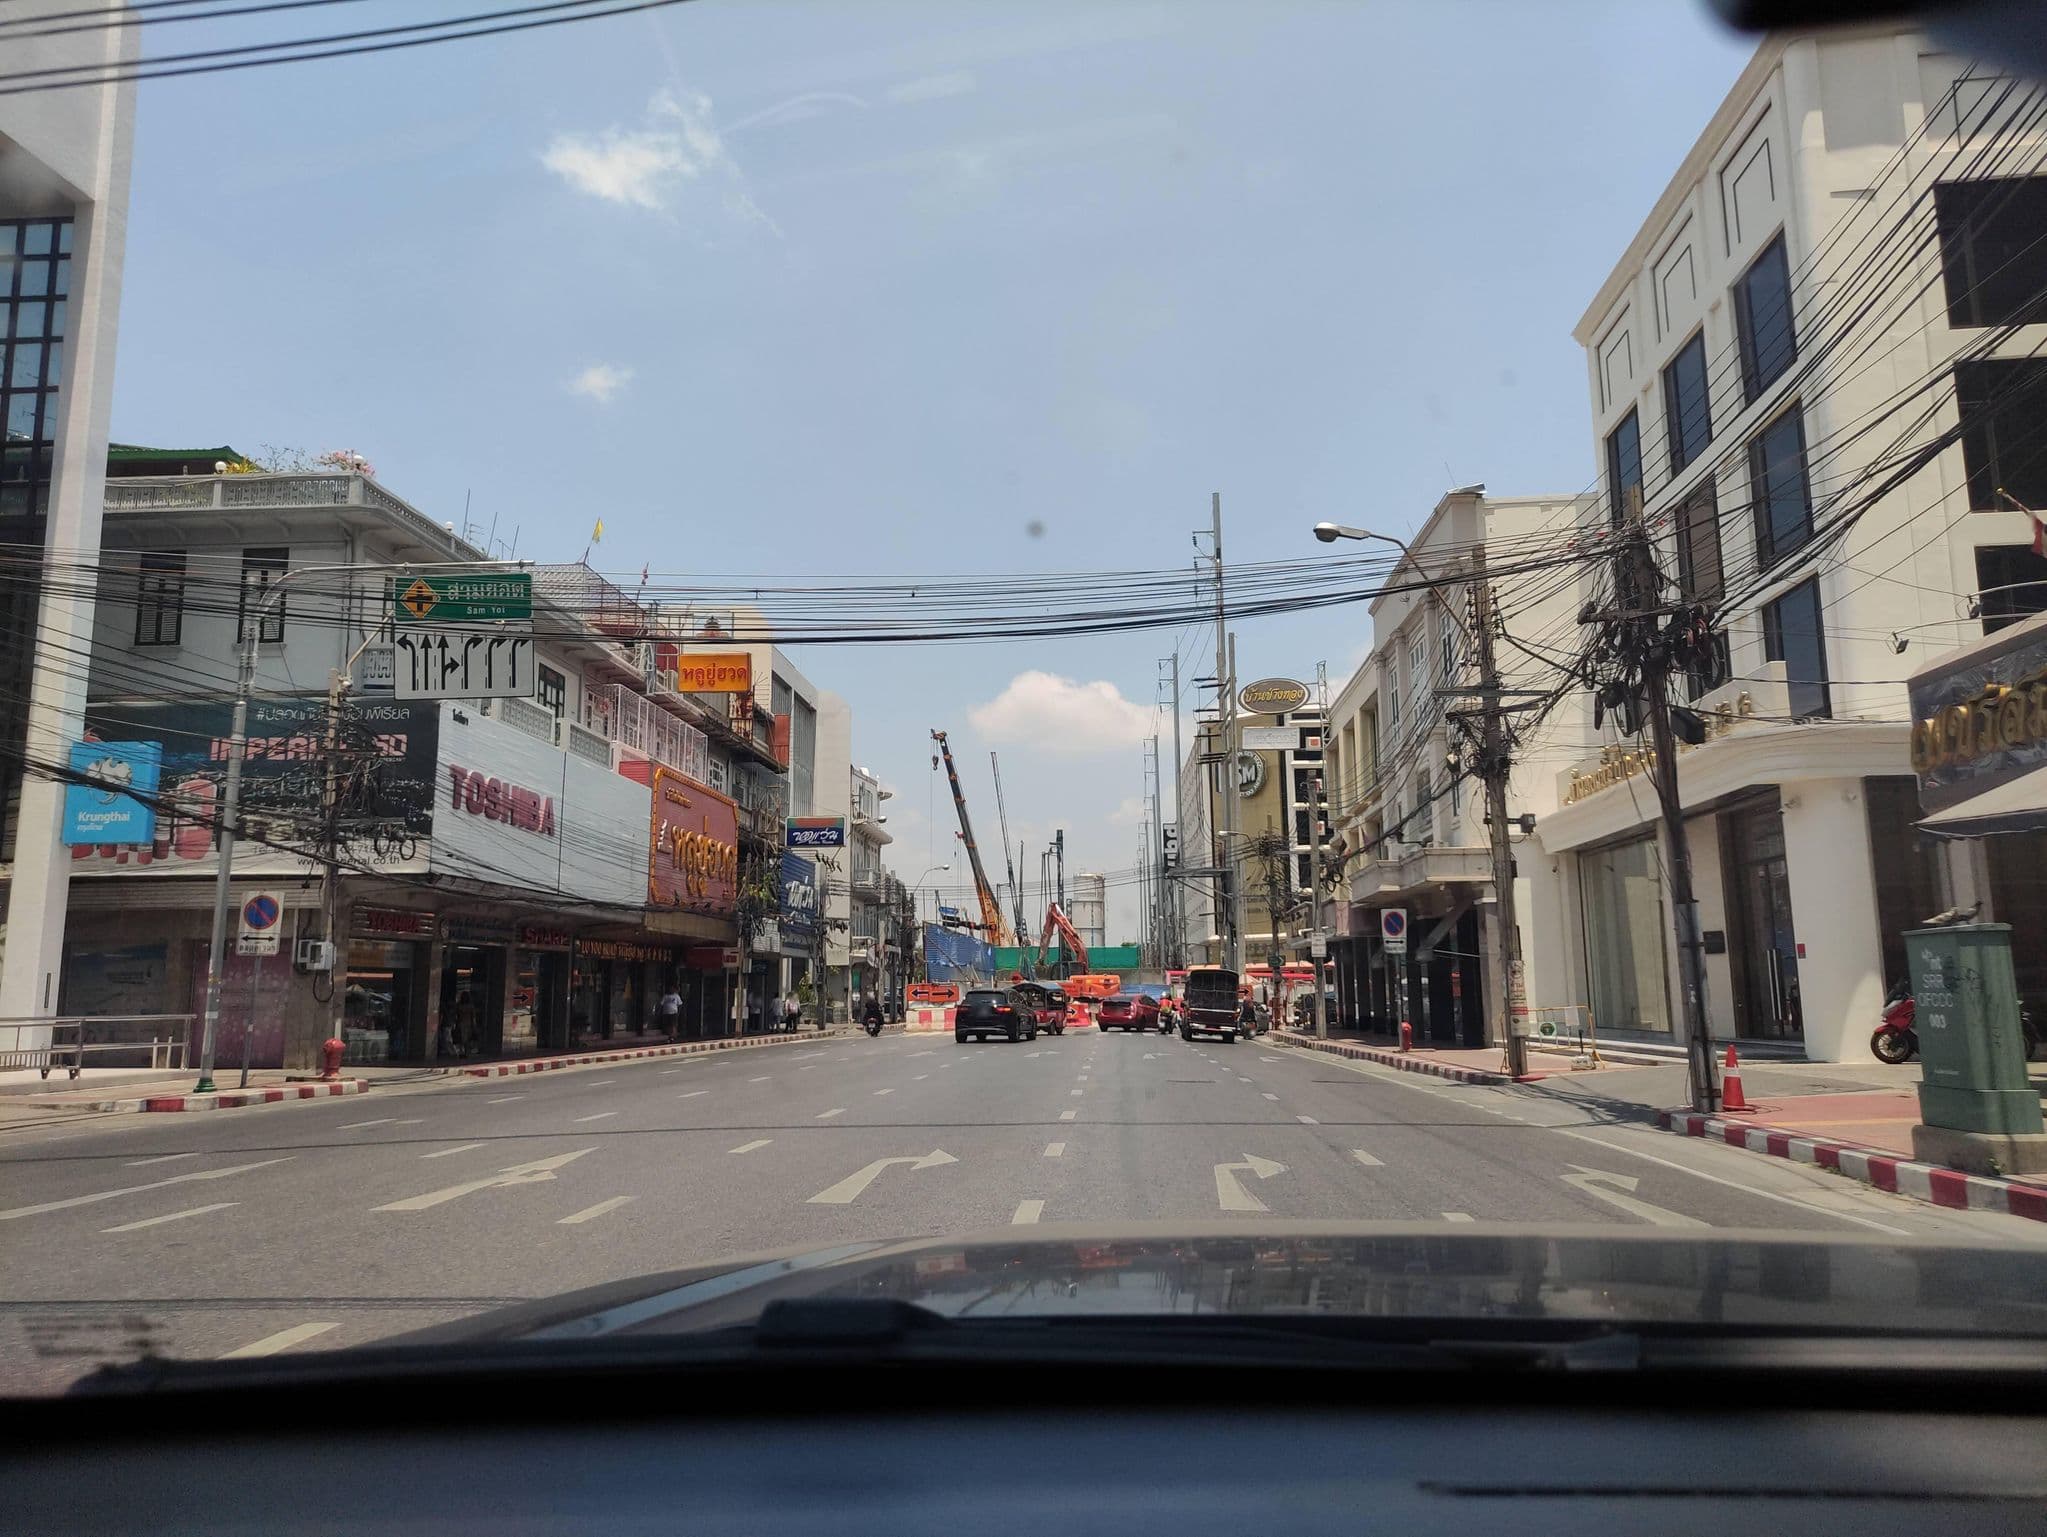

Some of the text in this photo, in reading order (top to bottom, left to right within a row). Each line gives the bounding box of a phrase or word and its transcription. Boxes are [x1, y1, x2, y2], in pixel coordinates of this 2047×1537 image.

[466, 606, 486, 615] Sam
[682, 662, 747, 688] หลูยู่ฮวด
[449, 763, 555, 837] TOSHIBA
[78, 811, 130, 824] Krungthai
